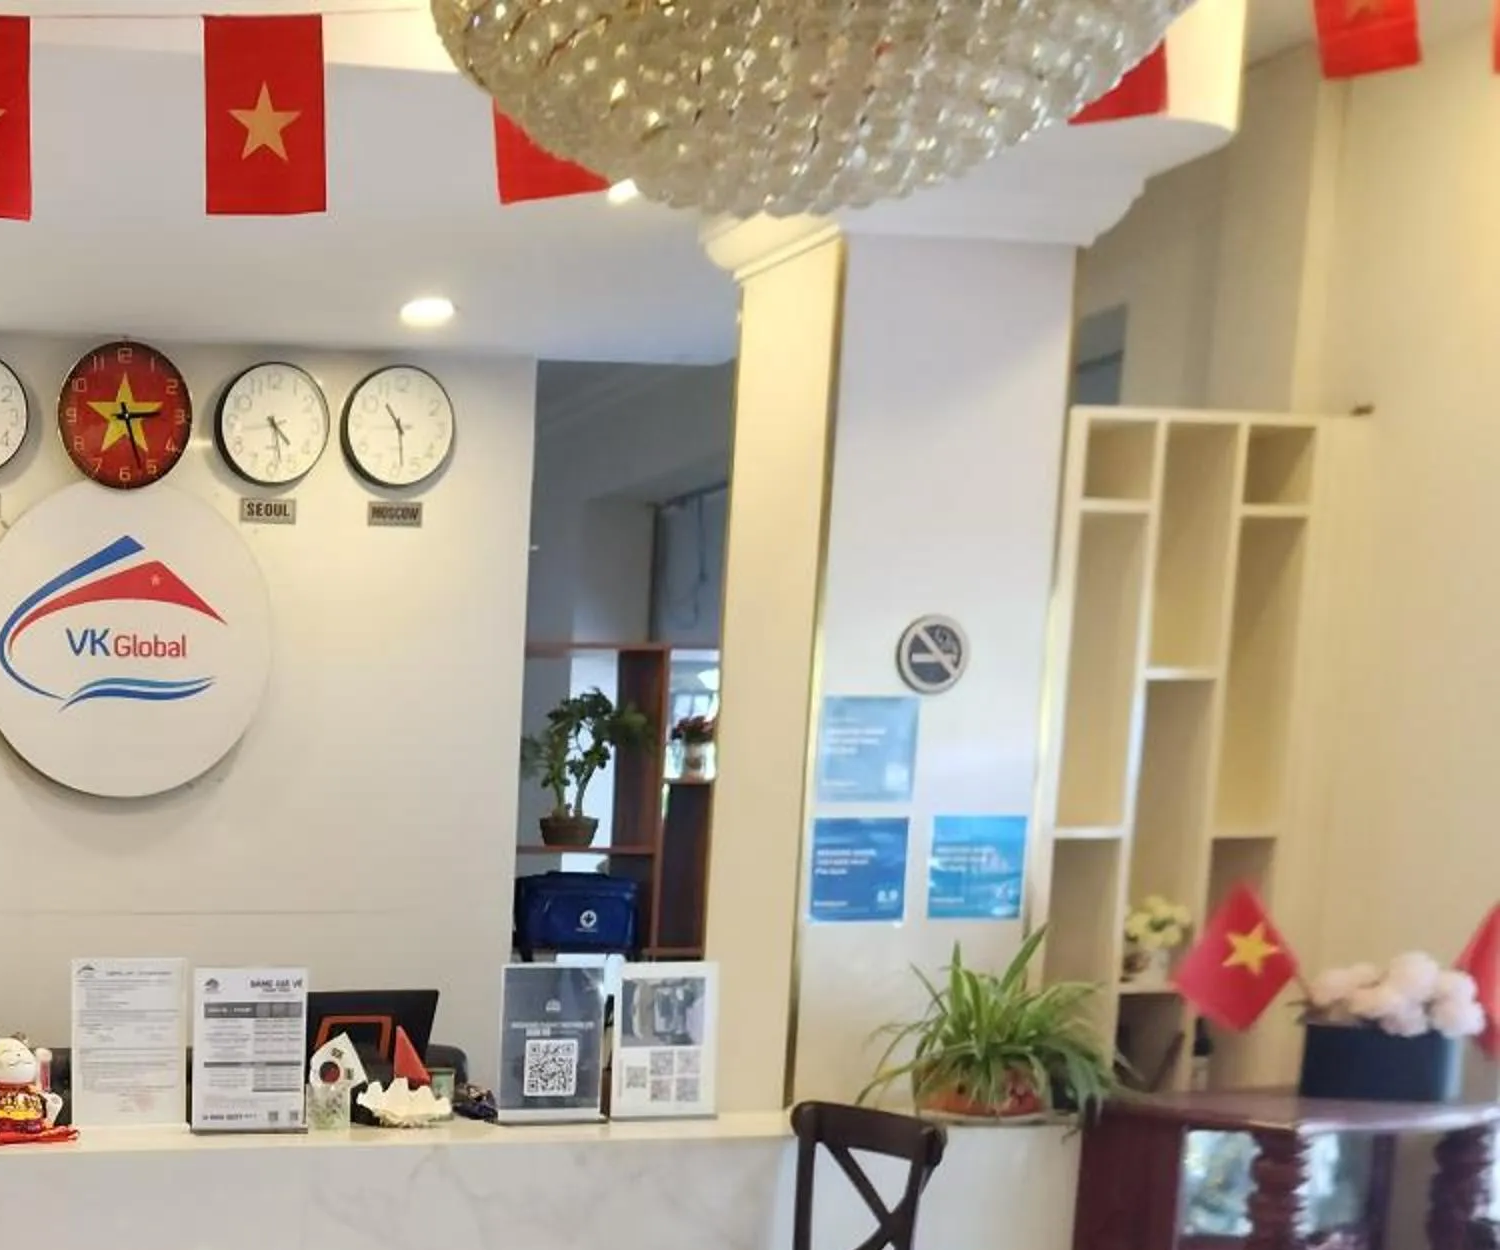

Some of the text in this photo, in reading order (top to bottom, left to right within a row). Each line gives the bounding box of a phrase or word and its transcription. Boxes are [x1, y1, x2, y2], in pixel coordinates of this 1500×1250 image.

[92, 355, 105, 372] 11
[165, 378, 179, 395] 2
[66, 407, 78, 423] 9
[175, 409, 187, 425] 3
[73, 435, 86, 452] 8
[165, 437, 178, 453] 4
[89, 457, 103, 474] 7
[118, 466, 132, 481] 6
[145, 459, 158, 475] 5
[247, 502, 290, 517] SEOUL
[371, 505, 419, 520] MOSCOW
[65, 627, 187, 658] VK Global
